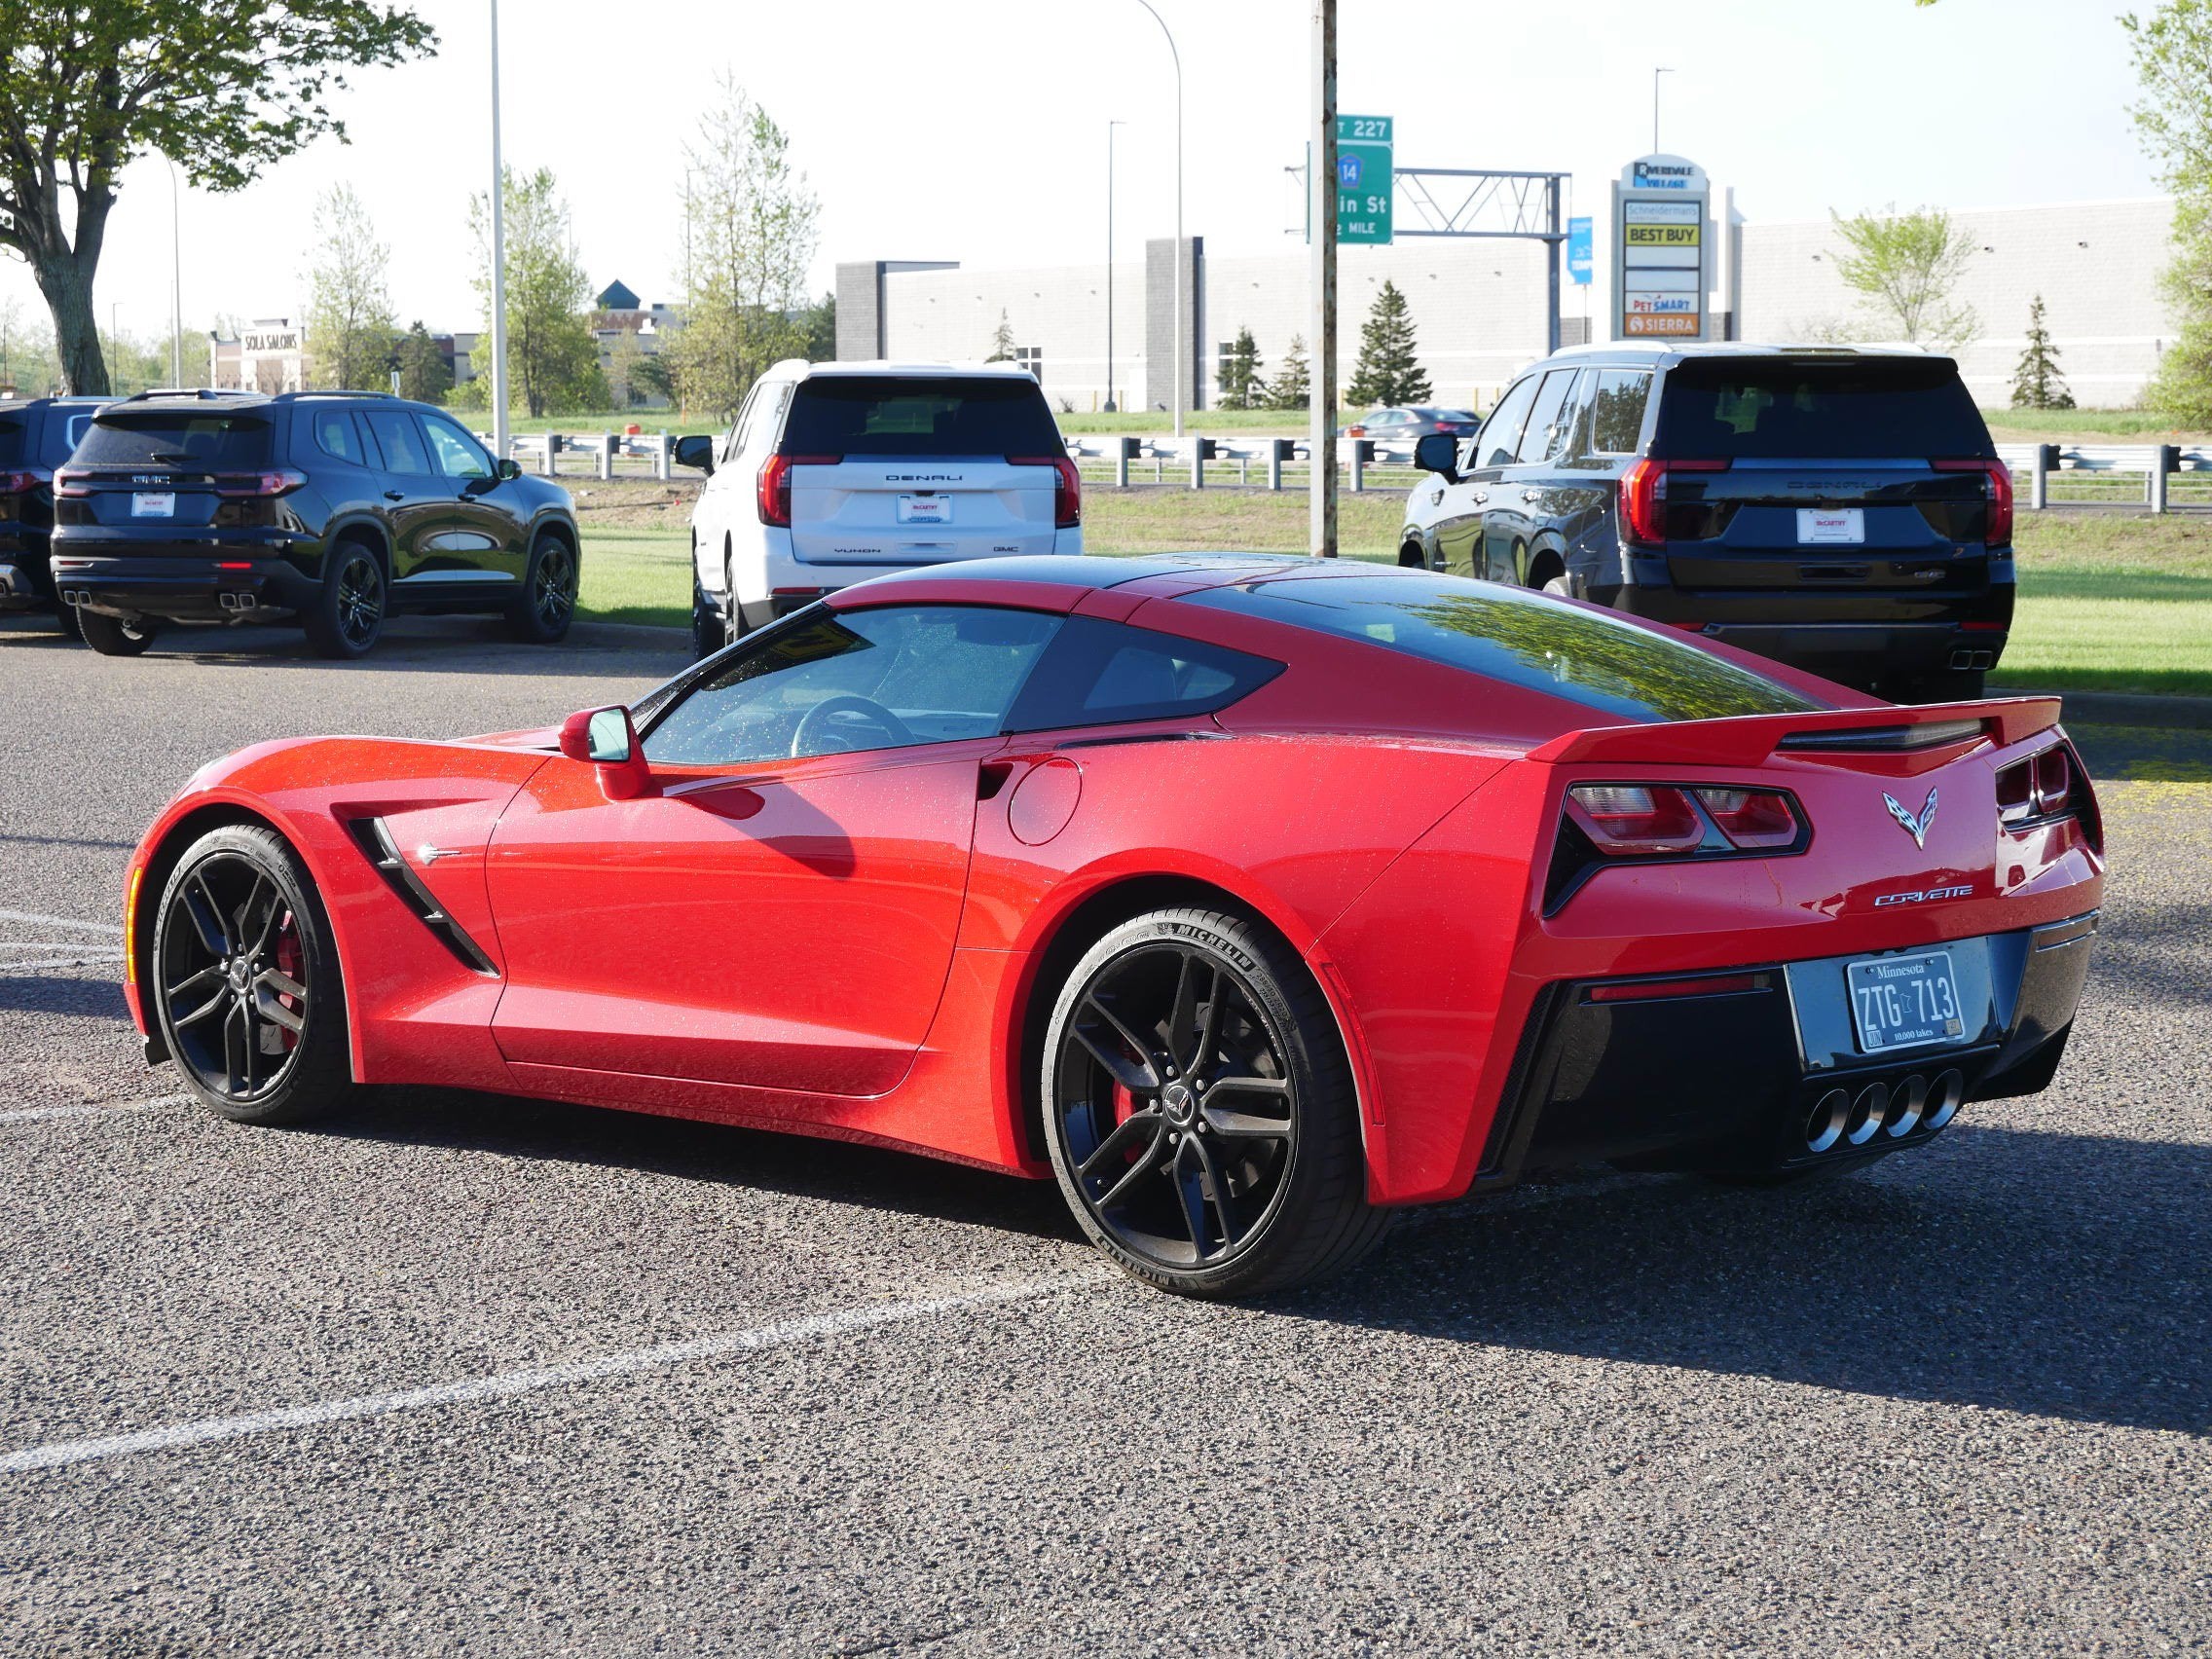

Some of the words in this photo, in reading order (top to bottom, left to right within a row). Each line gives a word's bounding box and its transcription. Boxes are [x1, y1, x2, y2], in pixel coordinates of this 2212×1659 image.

[1353, 120, 1386, 137] 227
[1343, 164, 1356, 180] 14
[1339, 196, 1357, 213] in
[1367, 196, 1386, 214] St
[1348, 222, 1376, 235] MILE
[1630, 228, 1664, 241] BEST
[1667, 228, 1695, 241] BUY
[1645, 318, 1694, 332] SIERRA
[245, 334, 266, 351] SOLA
[267, 333, 298, 350] SALONS
[131, 475, 170, 485] GMC
[1788, 480, 1883, 490] DENALI
[1874, 884, 1974, 906] CORVETTE
[1175, 923, 1253, 970] MICHELIN
[1876, 964, 1925, 979] Minnesota
[1858, 983, 1902, 1032] ZTG
[1911, 977, 1955, 1023] 713
[1894, 1030, 1915, 1042] 10,000
[1915, 1028, 1934, 1040] lakes
[1100, 1238, 1169, 1286] MICHELIN
